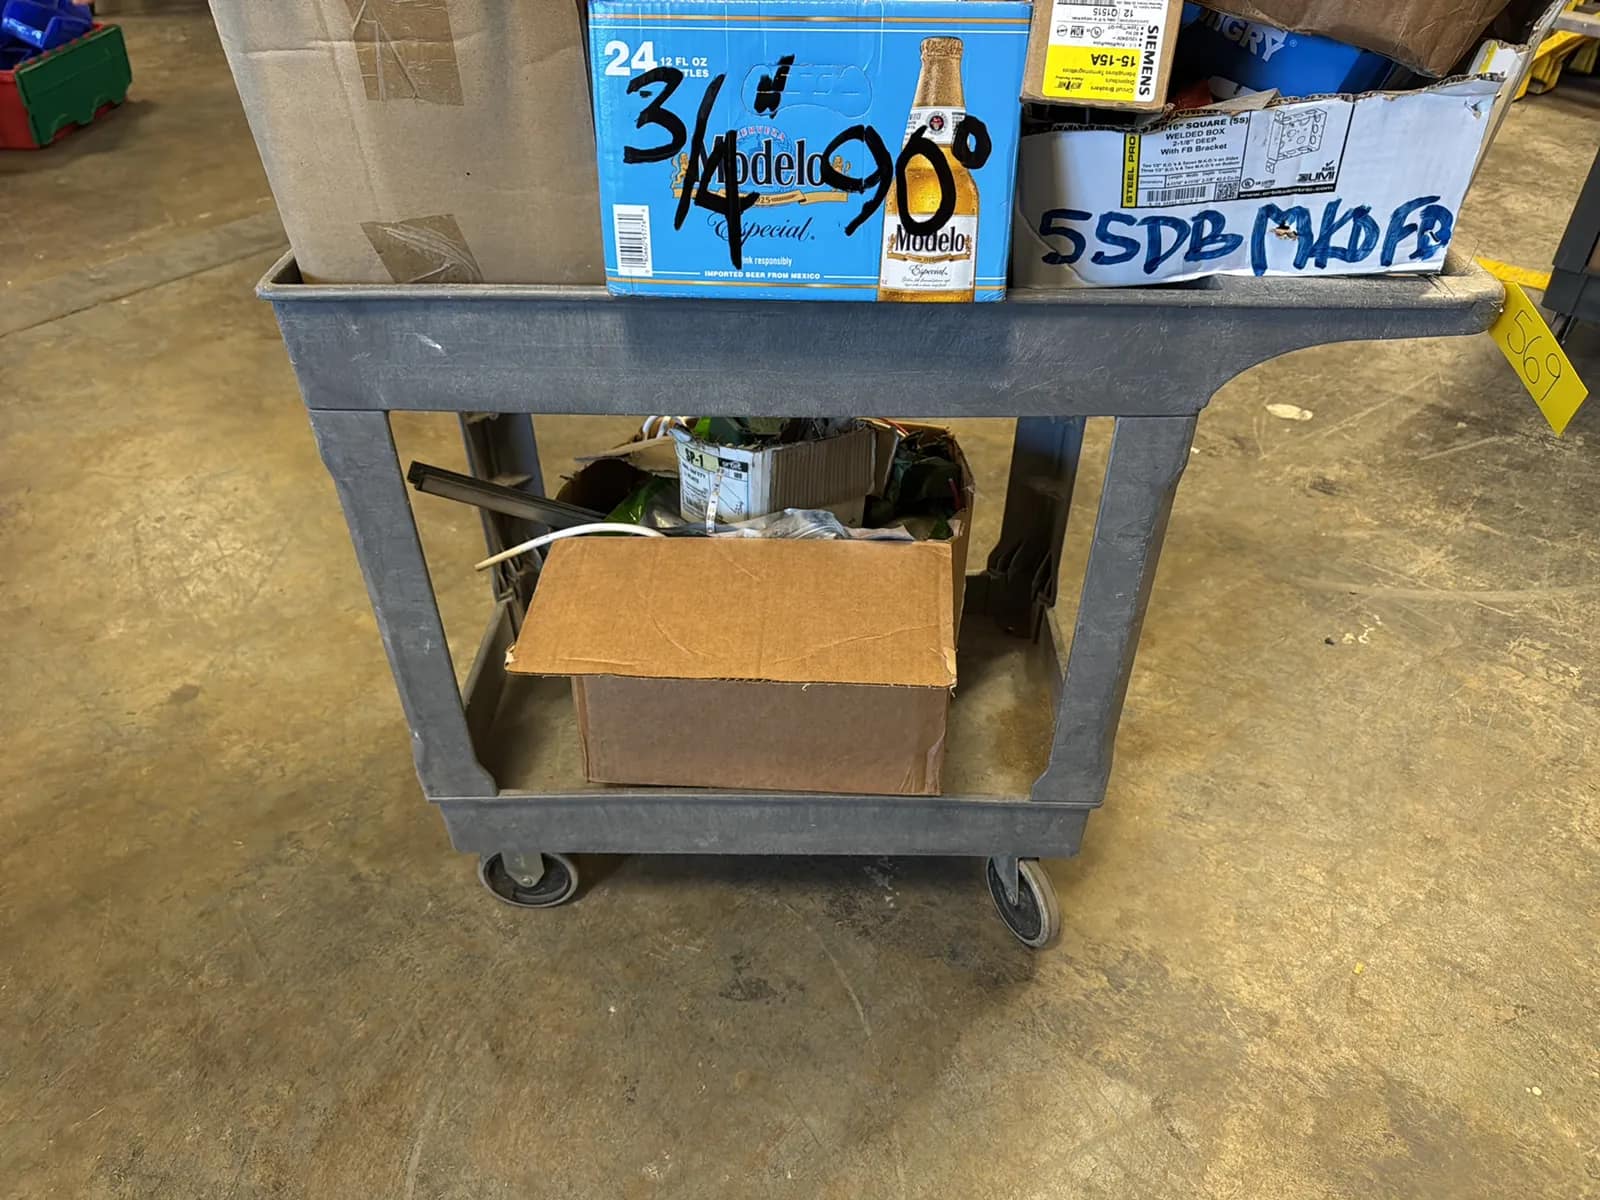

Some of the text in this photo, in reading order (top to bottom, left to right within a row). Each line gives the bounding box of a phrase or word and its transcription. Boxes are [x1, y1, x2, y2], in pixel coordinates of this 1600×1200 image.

[1092, 8, 1118, 17] Q1515
[1123, 9, 1134, 17] 12
[603, 40, 658, 76] 24
[660, 57, 708, 66] 12 FL OZ
[1091, 53, 1137, 67] 15-15A
[1138, 25, 1159, 96] SIEMENS
[1186, 118, 1228, 130] SQUARE
[1165, 128, 1226, 141] WELDED BOX
[1195, 136, 1217, 144] DEEP
[1160, 143, 1228, 156] With FB Bracket
[1126, 136, 1136, 203] STEEL PRO
[895, 224, 965, 252] Modelo
[1040, 209, 1244, 275] 5SDB
[755, 257, 793, 267] responsibly
[1506, 310, 1561, 401] 569
[684, 448, 704, 468] SP-1
